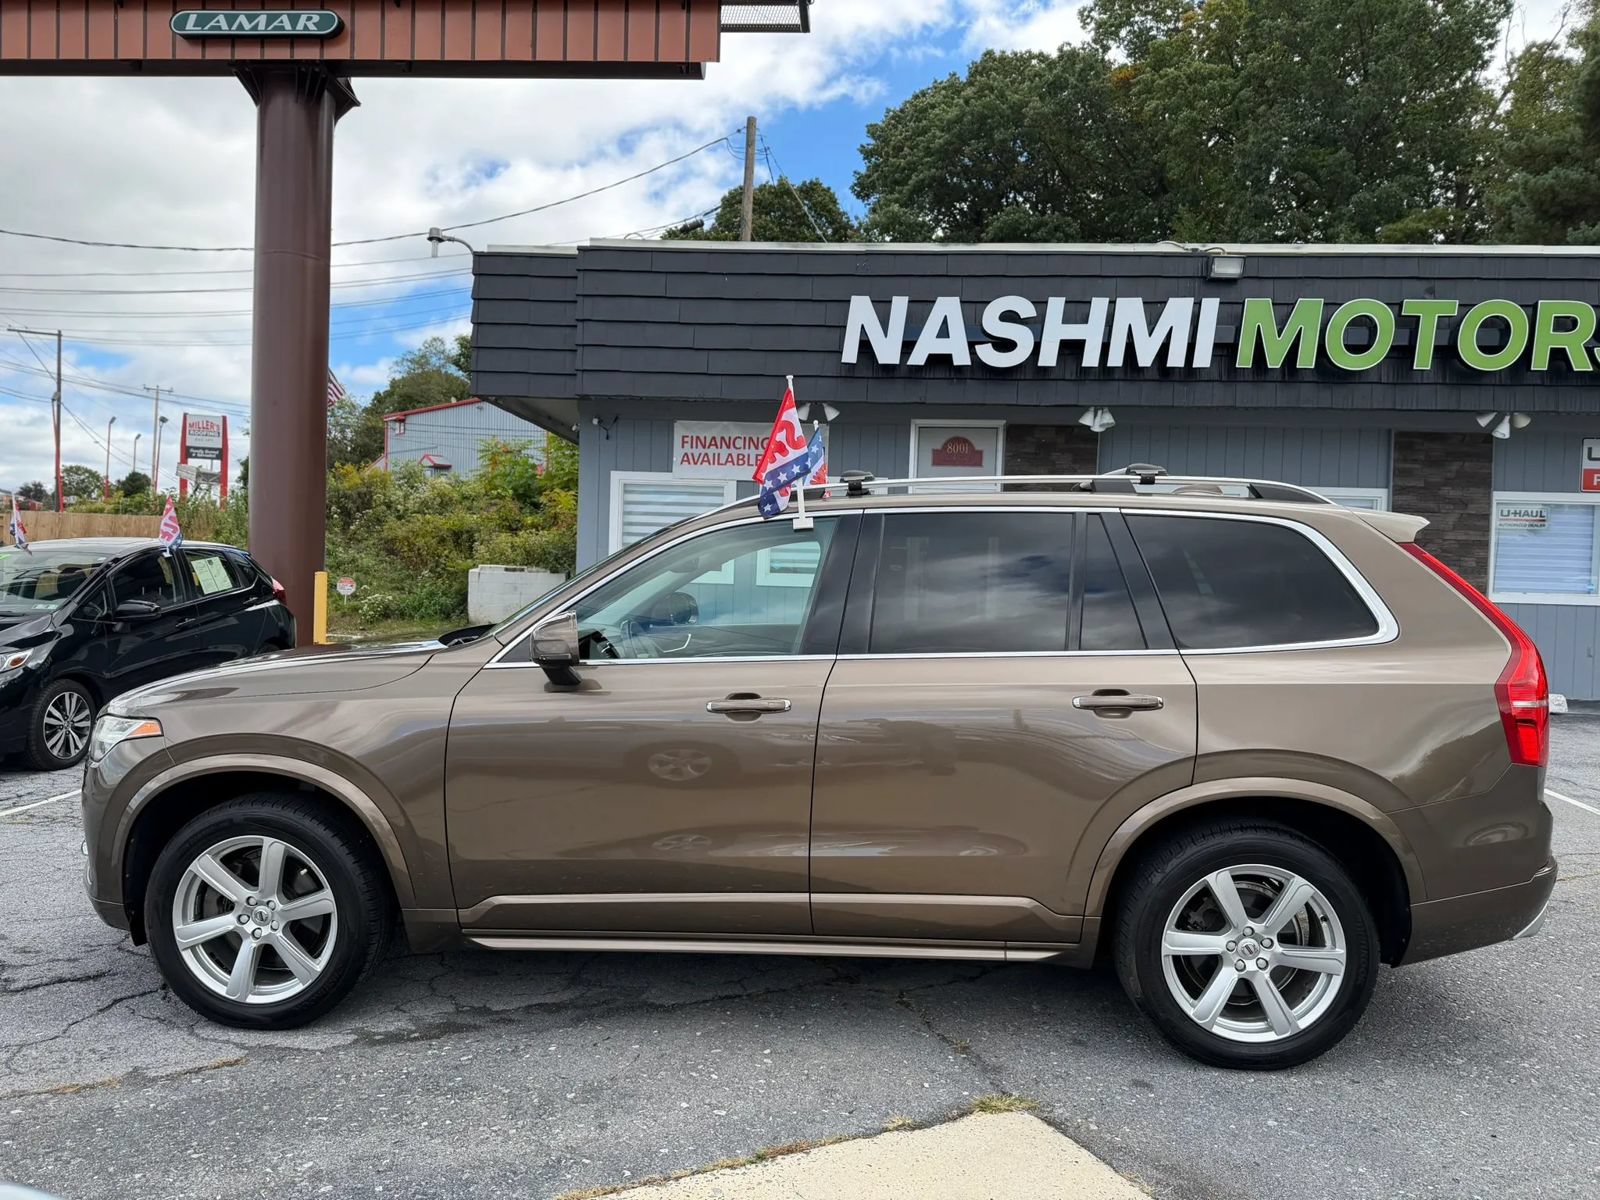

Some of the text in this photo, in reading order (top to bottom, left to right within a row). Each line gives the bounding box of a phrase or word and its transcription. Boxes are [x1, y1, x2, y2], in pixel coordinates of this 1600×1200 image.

[185, 14, 320, 31] LAMAR
[841, 295, 1600, 372] NASHMI MOTOR
[680, 452, 761, 467] AVAILABLE
[1500, 509, 1546, 518] U-HAUL
